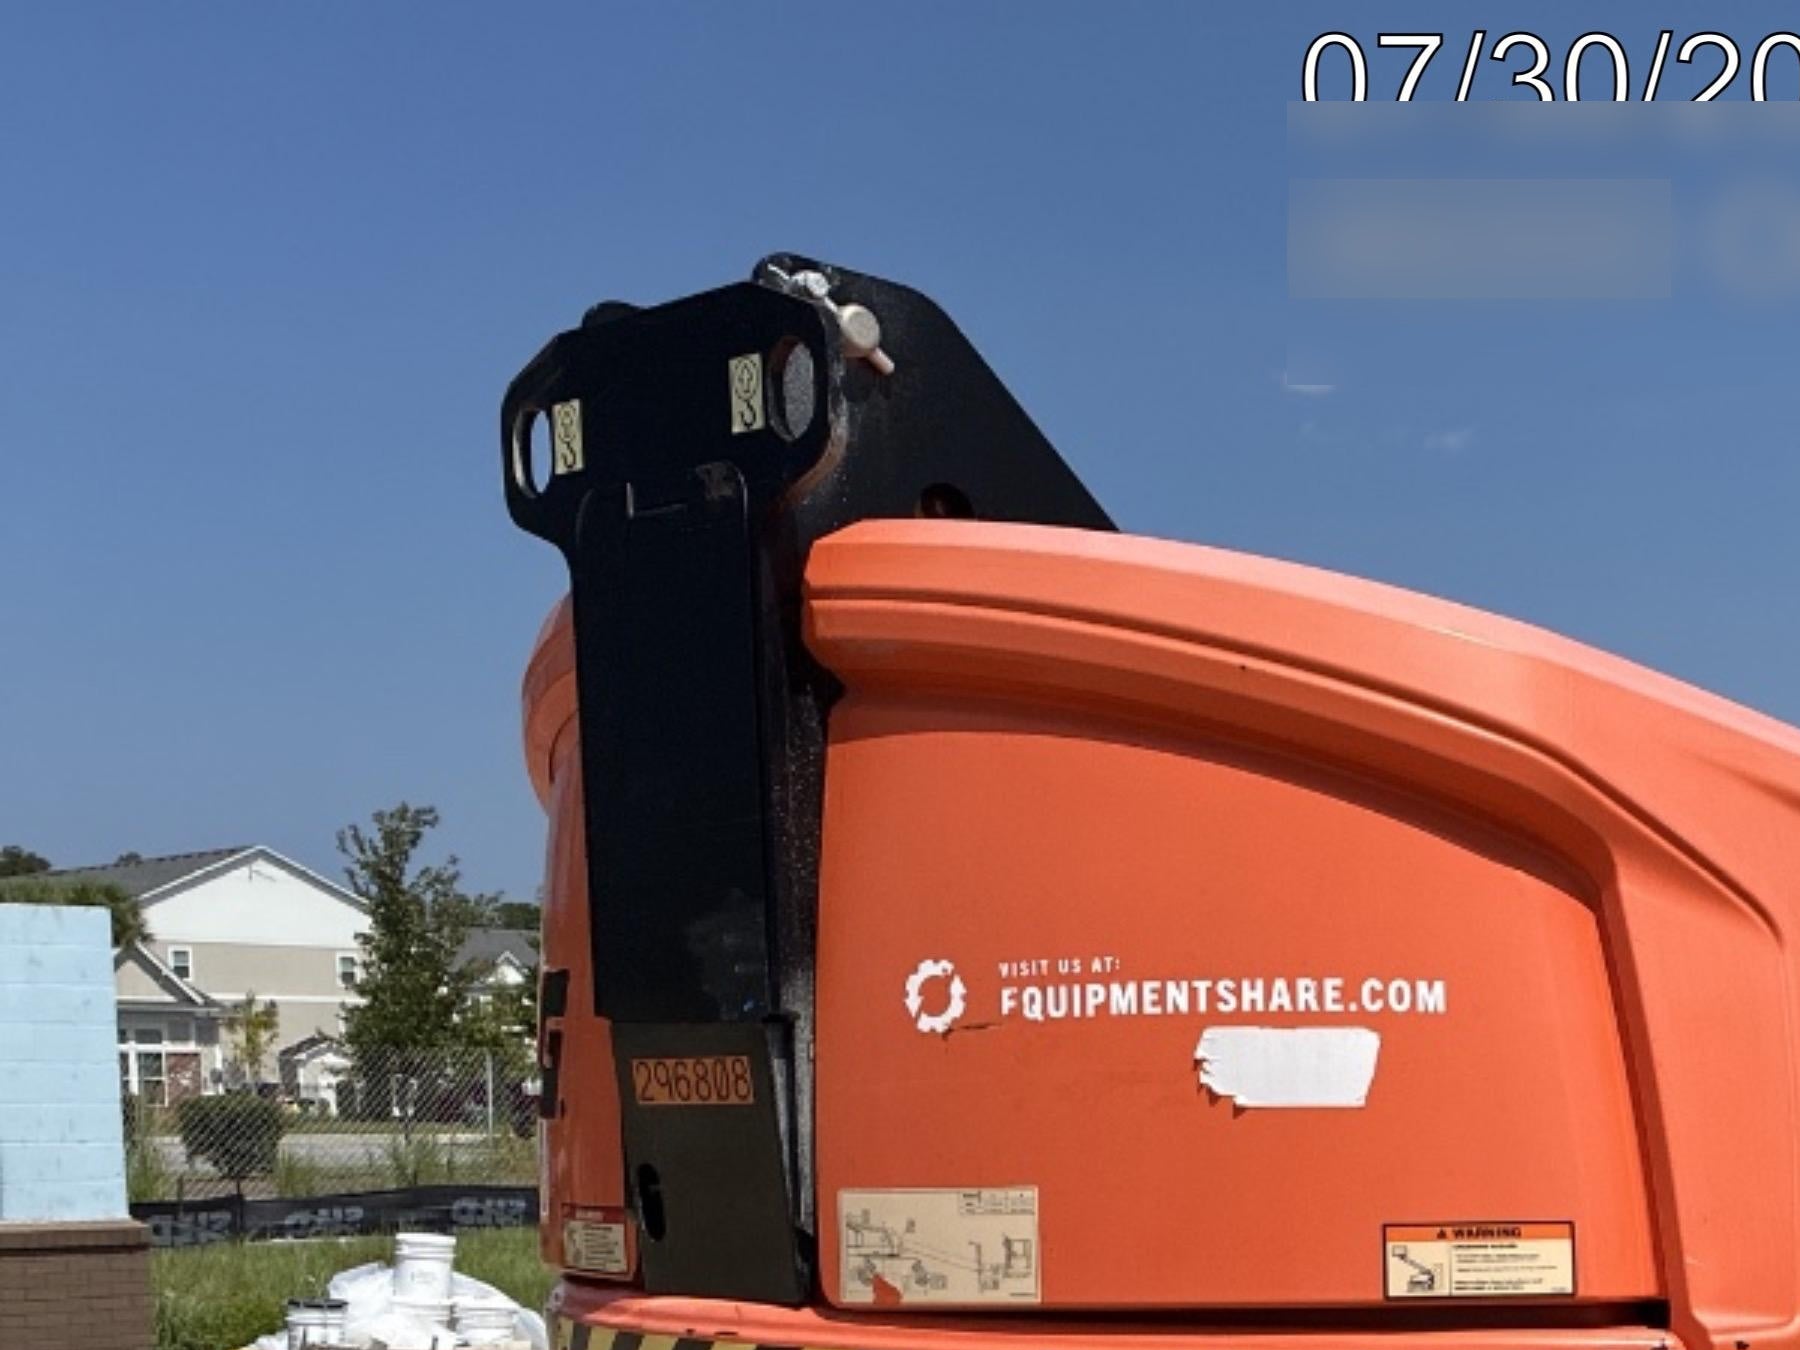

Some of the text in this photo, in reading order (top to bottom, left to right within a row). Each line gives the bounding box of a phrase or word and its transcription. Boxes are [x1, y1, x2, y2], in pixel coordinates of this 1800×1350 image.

[999, 956, 1120, 978] VISIT US AT:
[635, 1057, 751, 1102] 296808
